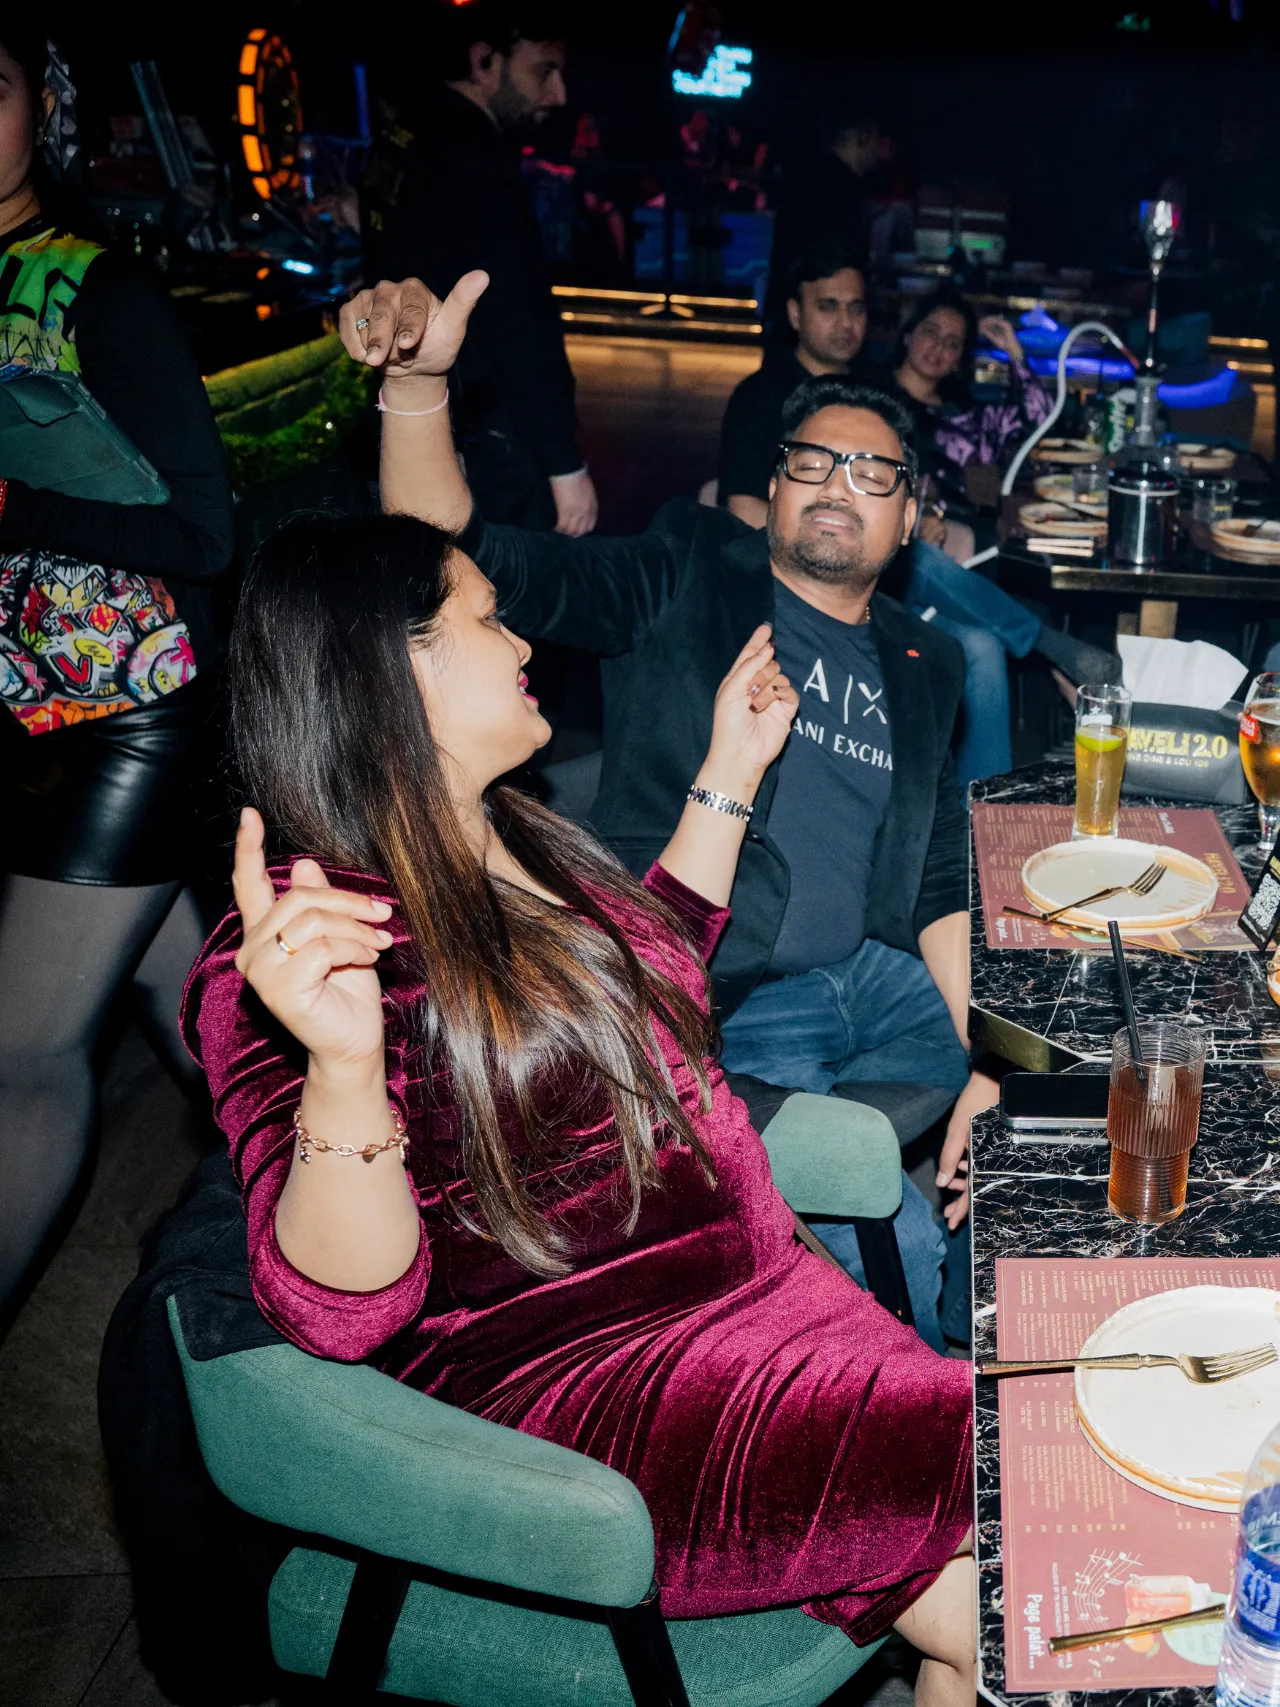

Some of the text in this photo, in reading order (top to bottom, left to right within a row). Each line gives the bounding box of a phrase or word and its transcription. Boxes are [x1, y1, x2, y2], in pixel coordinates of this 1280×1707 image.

[791, 717, 894, 772] ANI EXCHA
[1128, 728, 1229, 760] AVELI 2.0
[1174, 758, 1210, 769] LOUGE
[1023, 1594, 1044, 1624] Page
